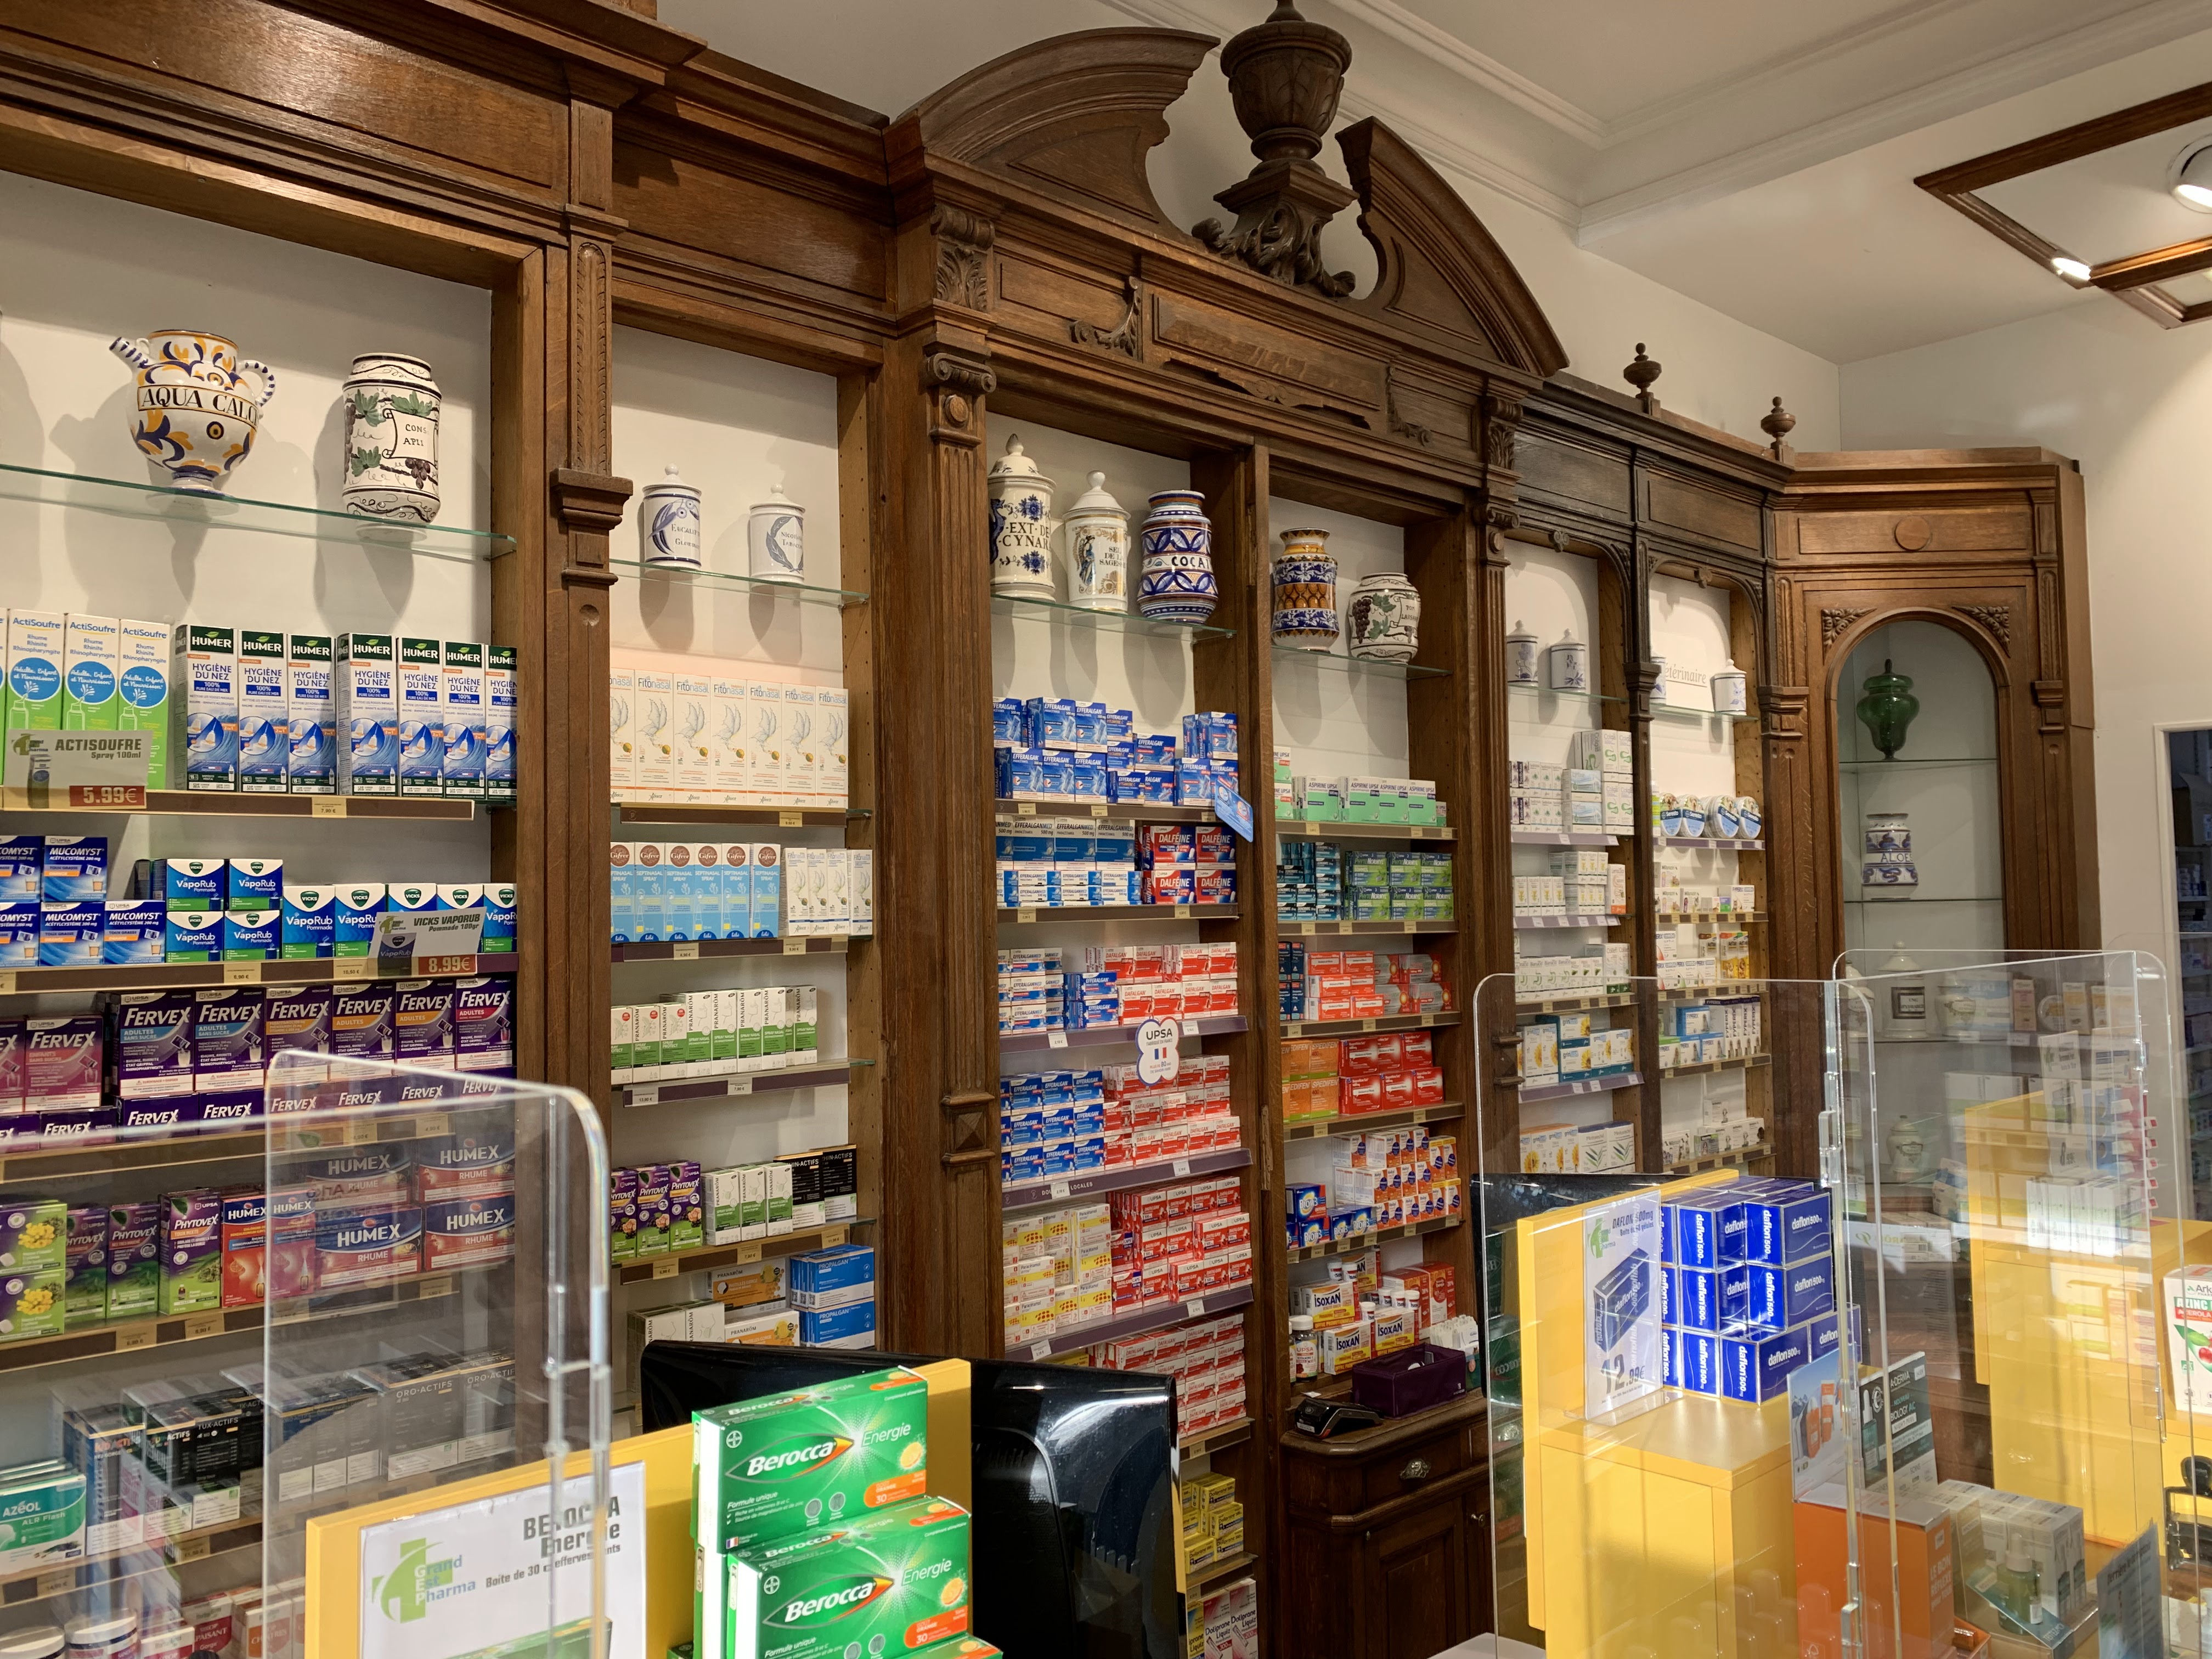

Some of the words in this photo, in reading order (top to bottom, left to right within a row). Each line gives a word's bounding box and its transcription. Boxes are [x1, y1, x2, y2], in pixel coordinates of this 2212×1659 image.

[142, 387, 202, 408] AQUA
[13, 617, 60, 629] ActiSoufre
[70, 622, 116, 634] ActiSoufre
[123, 627, 167, 639] ActiSoufre
[192, 636, 232, 648] HUMER
[243, 641, 282, 652] HUMER
[292, 645, 330, 656] HUMER
[354, 644, 390, 654] HUMER
[403, 648, 438, 658] HUMER
[447, 652, 480, 663] HUMER
[489, 656, 516, 665] HUME
[193, 662, 232, 673] HYGIÈNE
[244, 667, 282, 676] HYGIÈNE
[195, 671, 210, 680] DU
[212, 672, 229, 680] NEZ
[262, 676, 280, 684] NEZ
[294, 671, 330, 680] HYGIÈNE
[355, 670, 391, 679] HYGIÈNE
[404, 673, 438, 682] HYGIÈNE
[1664, 663, 1707, 685] étérinaire
[448, 676, 481, 685] HYGIÈNE
[1045, 703, 1071, 712] EFFERALGAN
[55, 739, 142, 751] ACTISOUFRE
[91, 752, 115, 760] Spray
[1013, 752, 1040, 761] EFFERALGAN
[1159, 832, 1190, 844] DALFÉINE
[1201, 832, 1232, 844] DALFÉINE
[49, 847, 102, 856] MUCOMYST
[176, 879, 216, 888] VapoRub
[239, 879, 275, 889] VapoRub
[1160, 876, 1191, 887] DALFÉINE
[45, 913, 98, 922] MUCOMYST
[109, 912, 160, 921] MUCOMYST
[286, 915, 332, 926] VapoRub
[414, 917, 439, 927] VICKS
[441, 913, 480, 926] VAPORUB
[175, 933, 216, 941] VapoRub
[428, 956, 470, 973] 8.99€
[399, 994, 453, 1012] FERVEX
[459, 990, 511, 1008] FERVEX
[270, 1000, 329, 1019] FERVEX
[336, 996, 393, 1015] FERVEX
[124, 1006, 191, 1026] FERVEX
[199, 1003, 262, 1023] FERVEX
[30, 1031, 95, 1049] FERVEX
[1146, 1028, 1172, 1040] UPSA
[1312, 1079, 1339, 1088] SPEDIFEN
[440, 1145, 499, 1165] HUMEX
[328, 1154, 390, 1175] HUMEX
[459, 1169, 488, 1180] RHUME
[348, 1180, 379, 1190] RHUME
[1070, 1181, 1093, 1190] LOCALES
[274, 1200, 312, 1214] HUMEX
[228, 1206, 266, 1221] HUMEX
[447, 1208, 505, 1231] HUMEX
[174, 1214, 218, 1230] PHYTOVEX
[1613, 1214, 1634, 1229] DAFLON
[1792, 1216, 1810, 1230] daflon
[112, 1226, 156, 1241] PHYTOVEX
[337, 1223, 400, 1248] HUMEX
[465, 1234, 494, 1245] RHUME
[358, 1250, 388, 1262] RHUME
[819, 1259, 848, 1269] PROPALGAN
[1795, 1278, 1813, 1293] daflon
[819, 1310, 850, 1320] PROPALGAN
[1909, 1401, 1916, 1412] AC
[747, 1441, 834, 1476] Berocca
[861, 1423, 911, 1447] Energie
[727, 1497, 755, 1509] Formule
[756, 1492, 778, 1502] unique
[876, 1493, 887, 1504] 30
[22, 1517, 40, 1526] ALR
[43, 1511, 66, 1522] Flash
[415, 1555, 462, 1578] Grand
[486, 1573, 511, 1589] Boite
[514, 1569, 525, 1580] de
[528, 1564, 540, 1577] 30
[415, 1580, 476, 1605] Pharma
[785, 1582, 873, 1622] Berocca
[902, 1558, 952, 1585] Energie
[1231, 1610, 1256, 1625] Doliprane
[1242, 1618, 1256, 1628] Liquiz
[195, 1627, 228, 1641] PAISANT
[1205, 1621, 1231, 1637] Doliprane
[1216, 1628, 1231, 1639] Liquiz
[916, 1633, 928, 1644] 30
